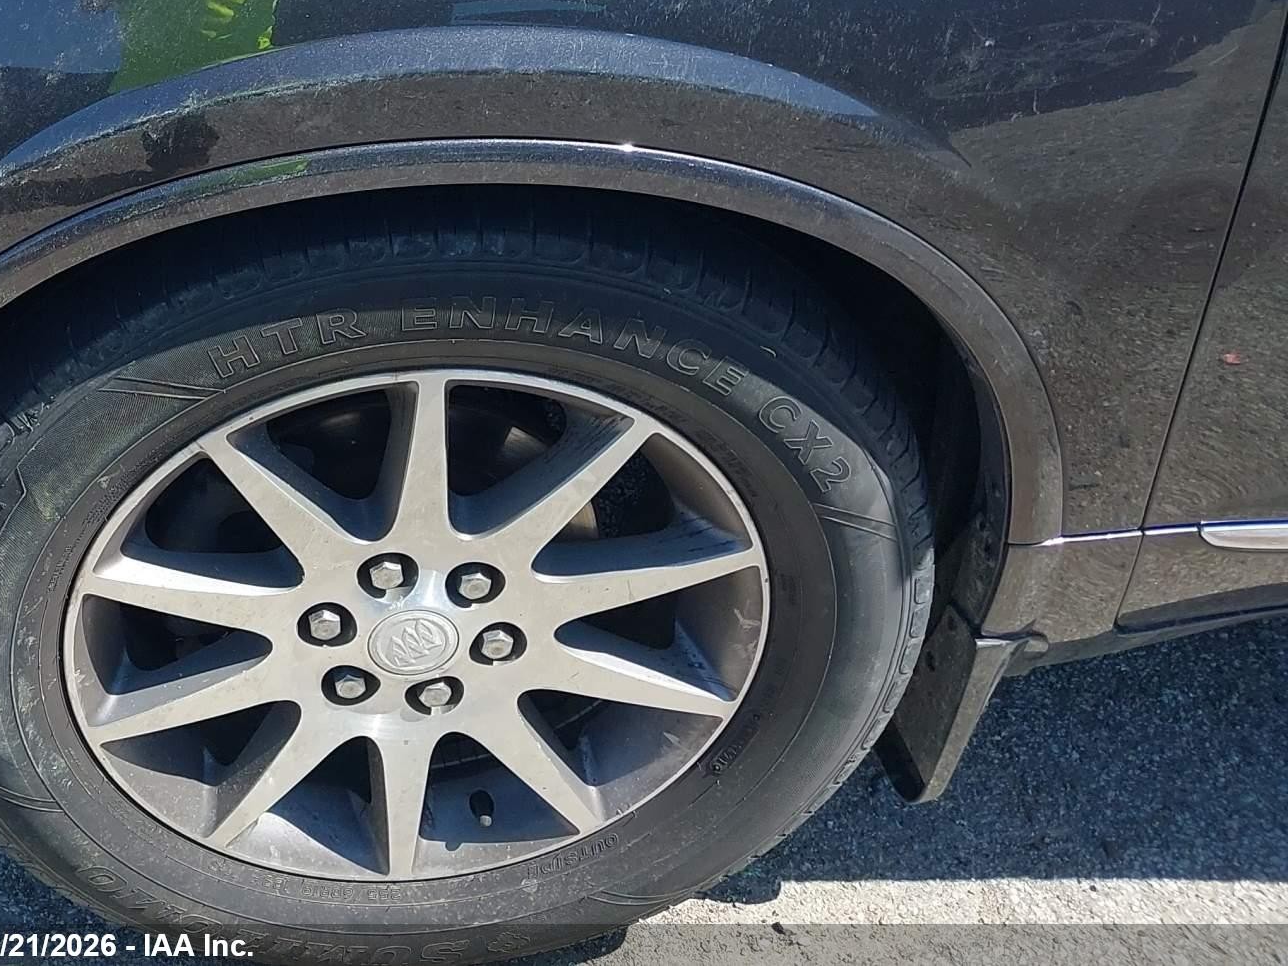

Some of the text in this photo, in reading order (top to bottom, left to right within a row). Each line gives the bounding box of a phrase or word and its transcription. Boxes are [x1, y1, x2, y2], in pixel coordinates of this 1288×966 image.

[207, 306, 367, 381] HTR
[401, 295, 748, 397] ENHANCE
[757, 395, 853, 494] CX2
